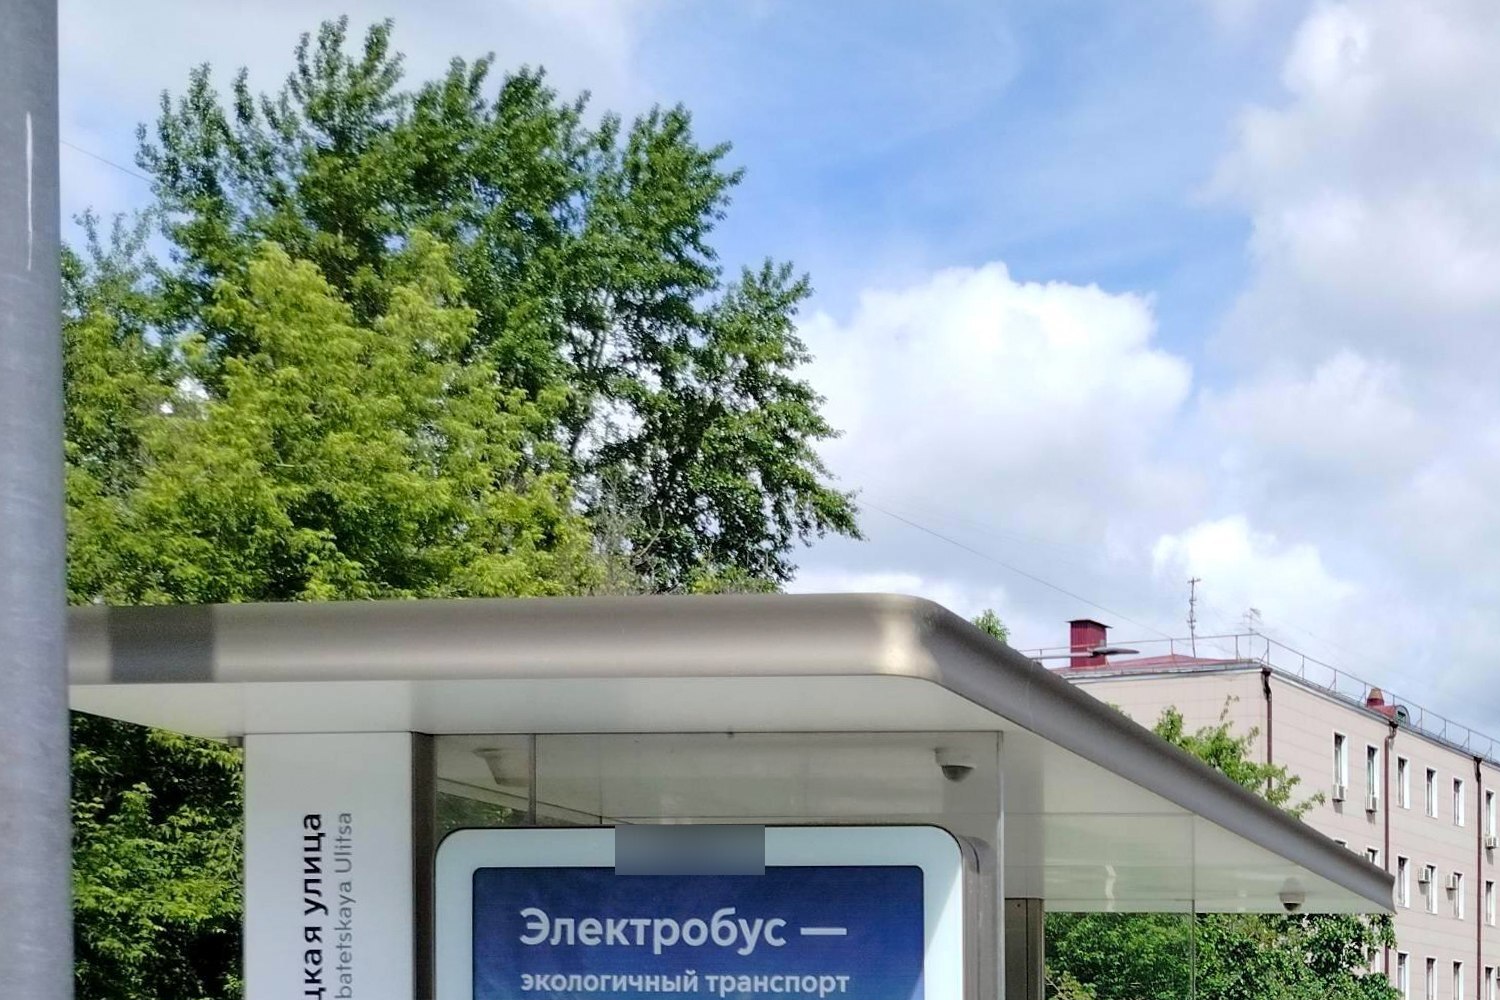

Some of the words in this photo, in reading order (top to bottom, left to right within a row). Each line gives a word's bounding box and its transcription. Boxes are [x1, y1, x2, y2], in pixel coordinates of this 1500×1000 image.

[302, 813, 330, 917] улица
[334, 812, 354, 873] Ulitsa
[520, 906, 787, 955] Электробус
[521, 969, 699, 993] экологичный
[705, 974, 850, 999] транспорт
